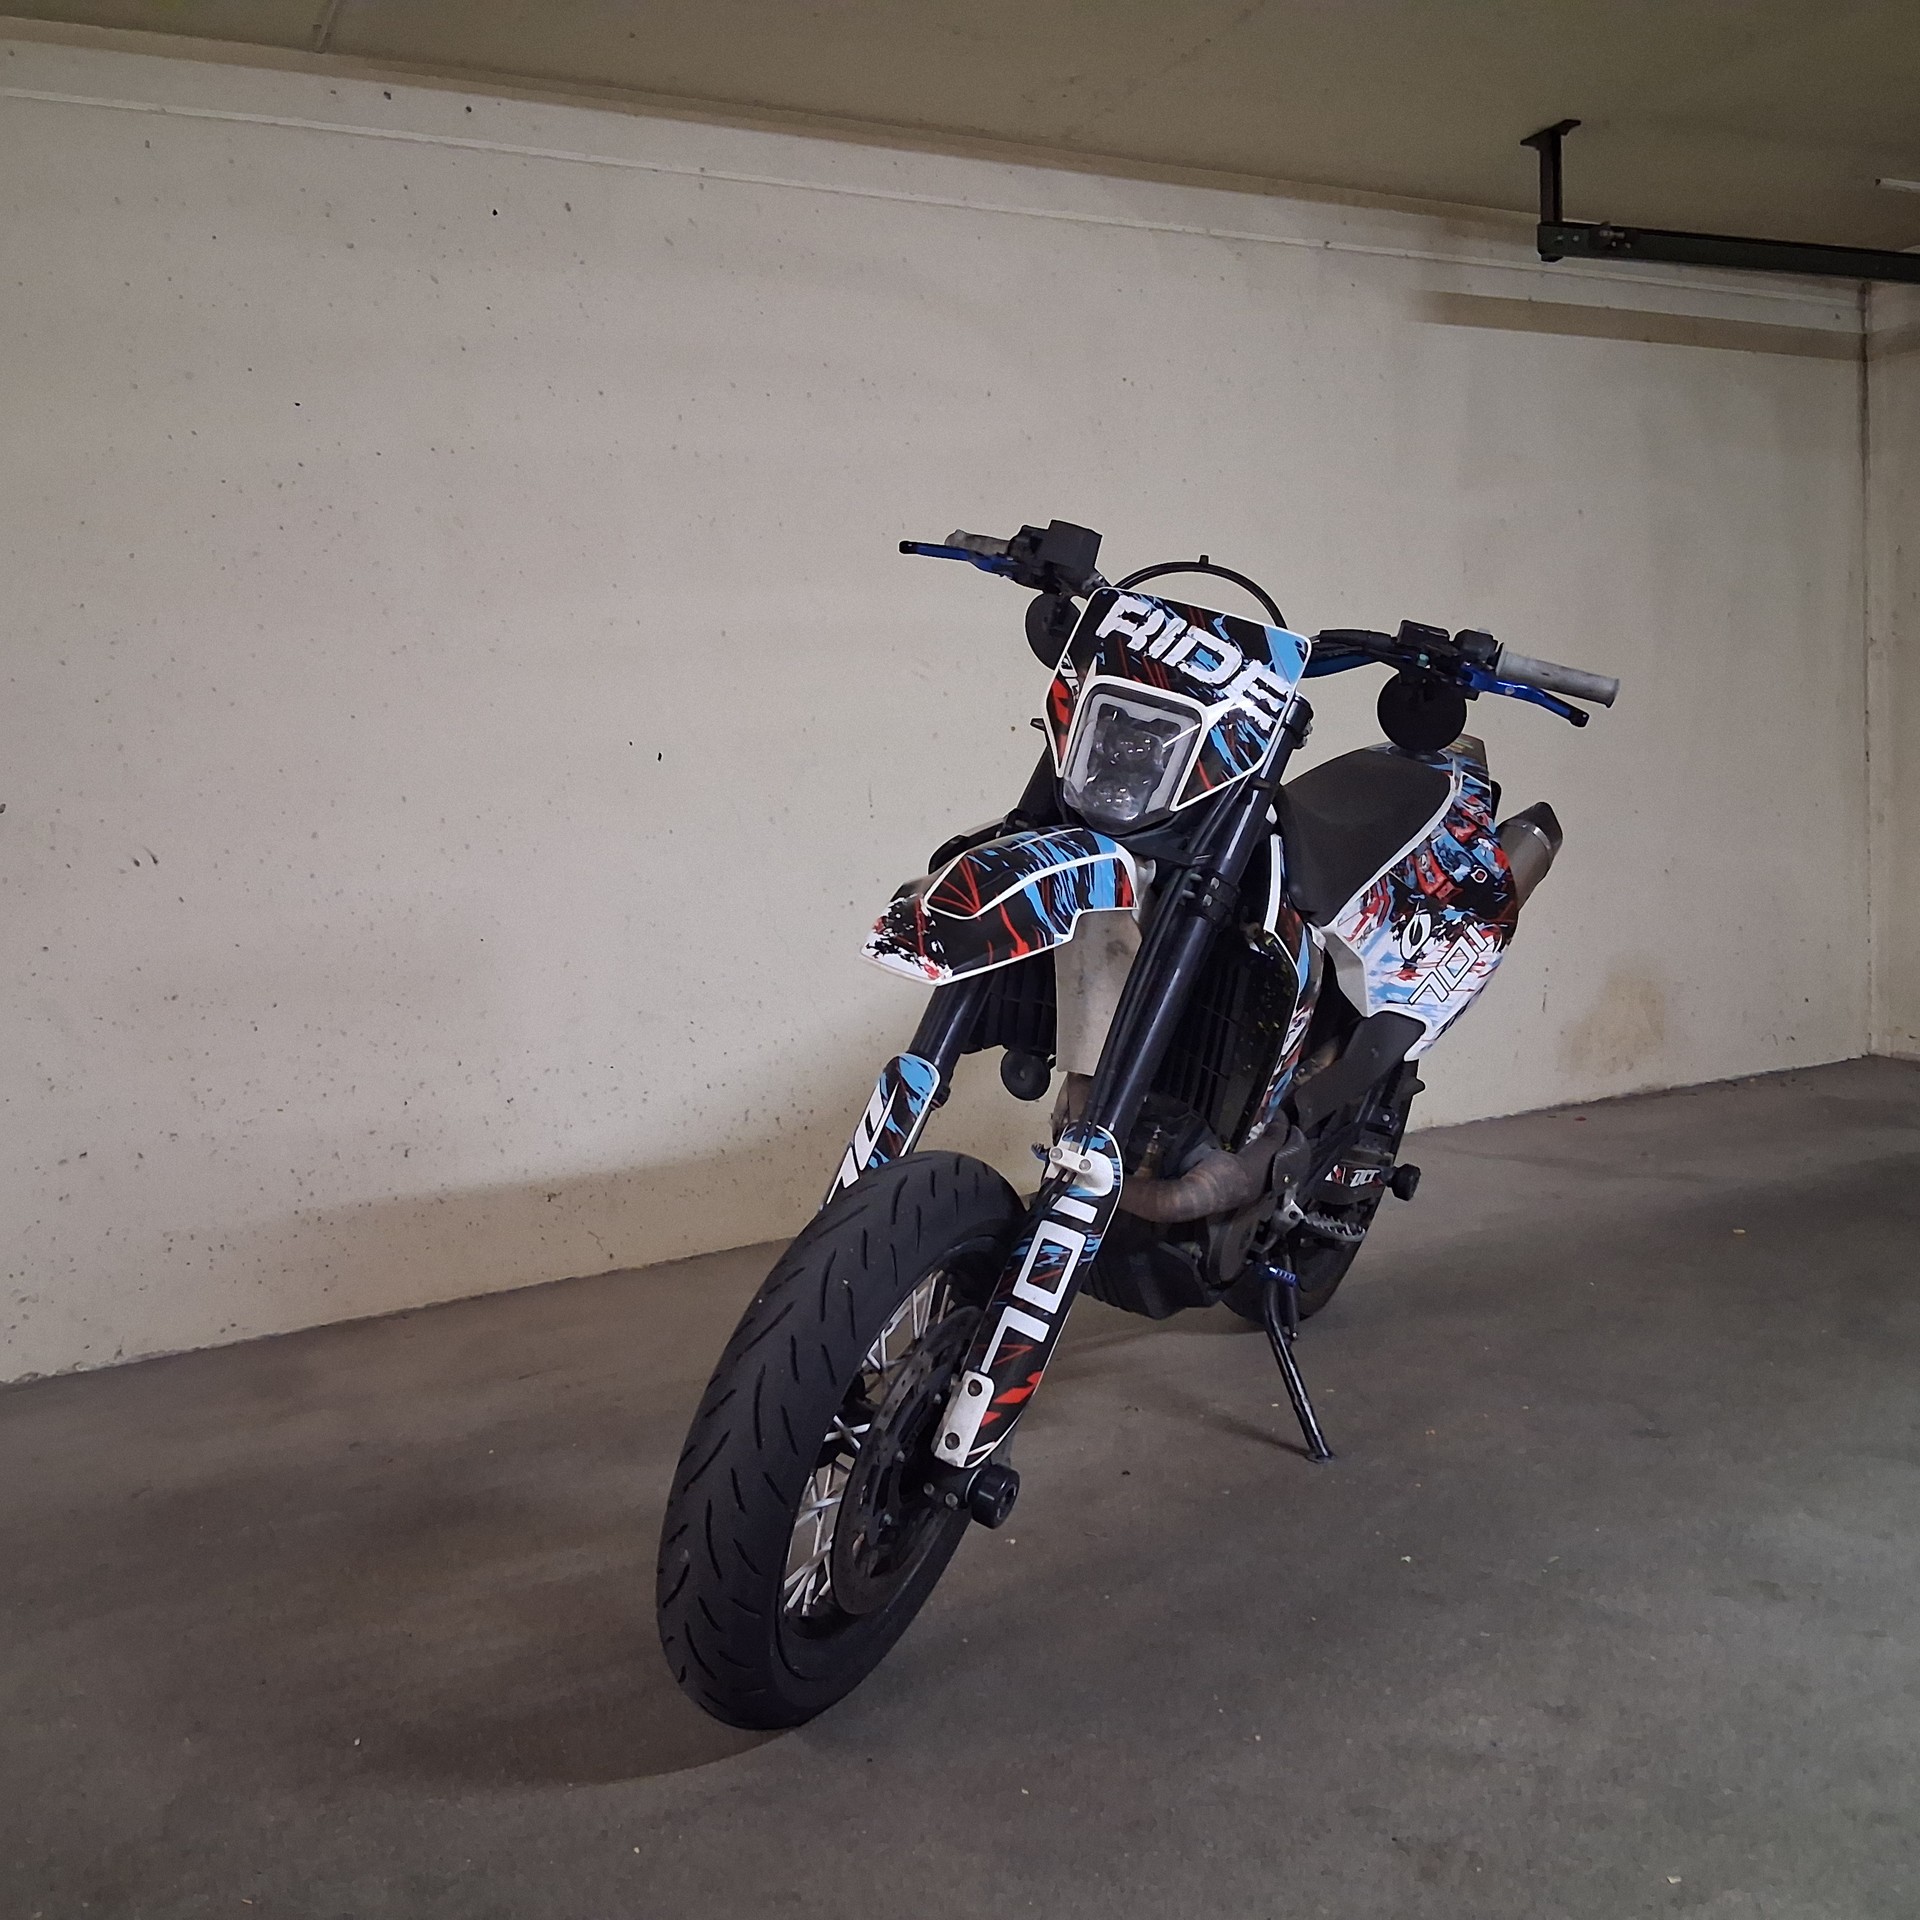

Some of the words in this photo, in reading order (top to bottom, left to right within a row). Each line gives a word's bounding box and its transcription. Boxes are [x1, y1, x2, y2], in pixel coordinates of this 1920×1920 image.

[1096, 595, 1292, 731] RIDE
[1408, 924, 1488, 1005] 701
[980, 1196, 1098, 1374] 701
